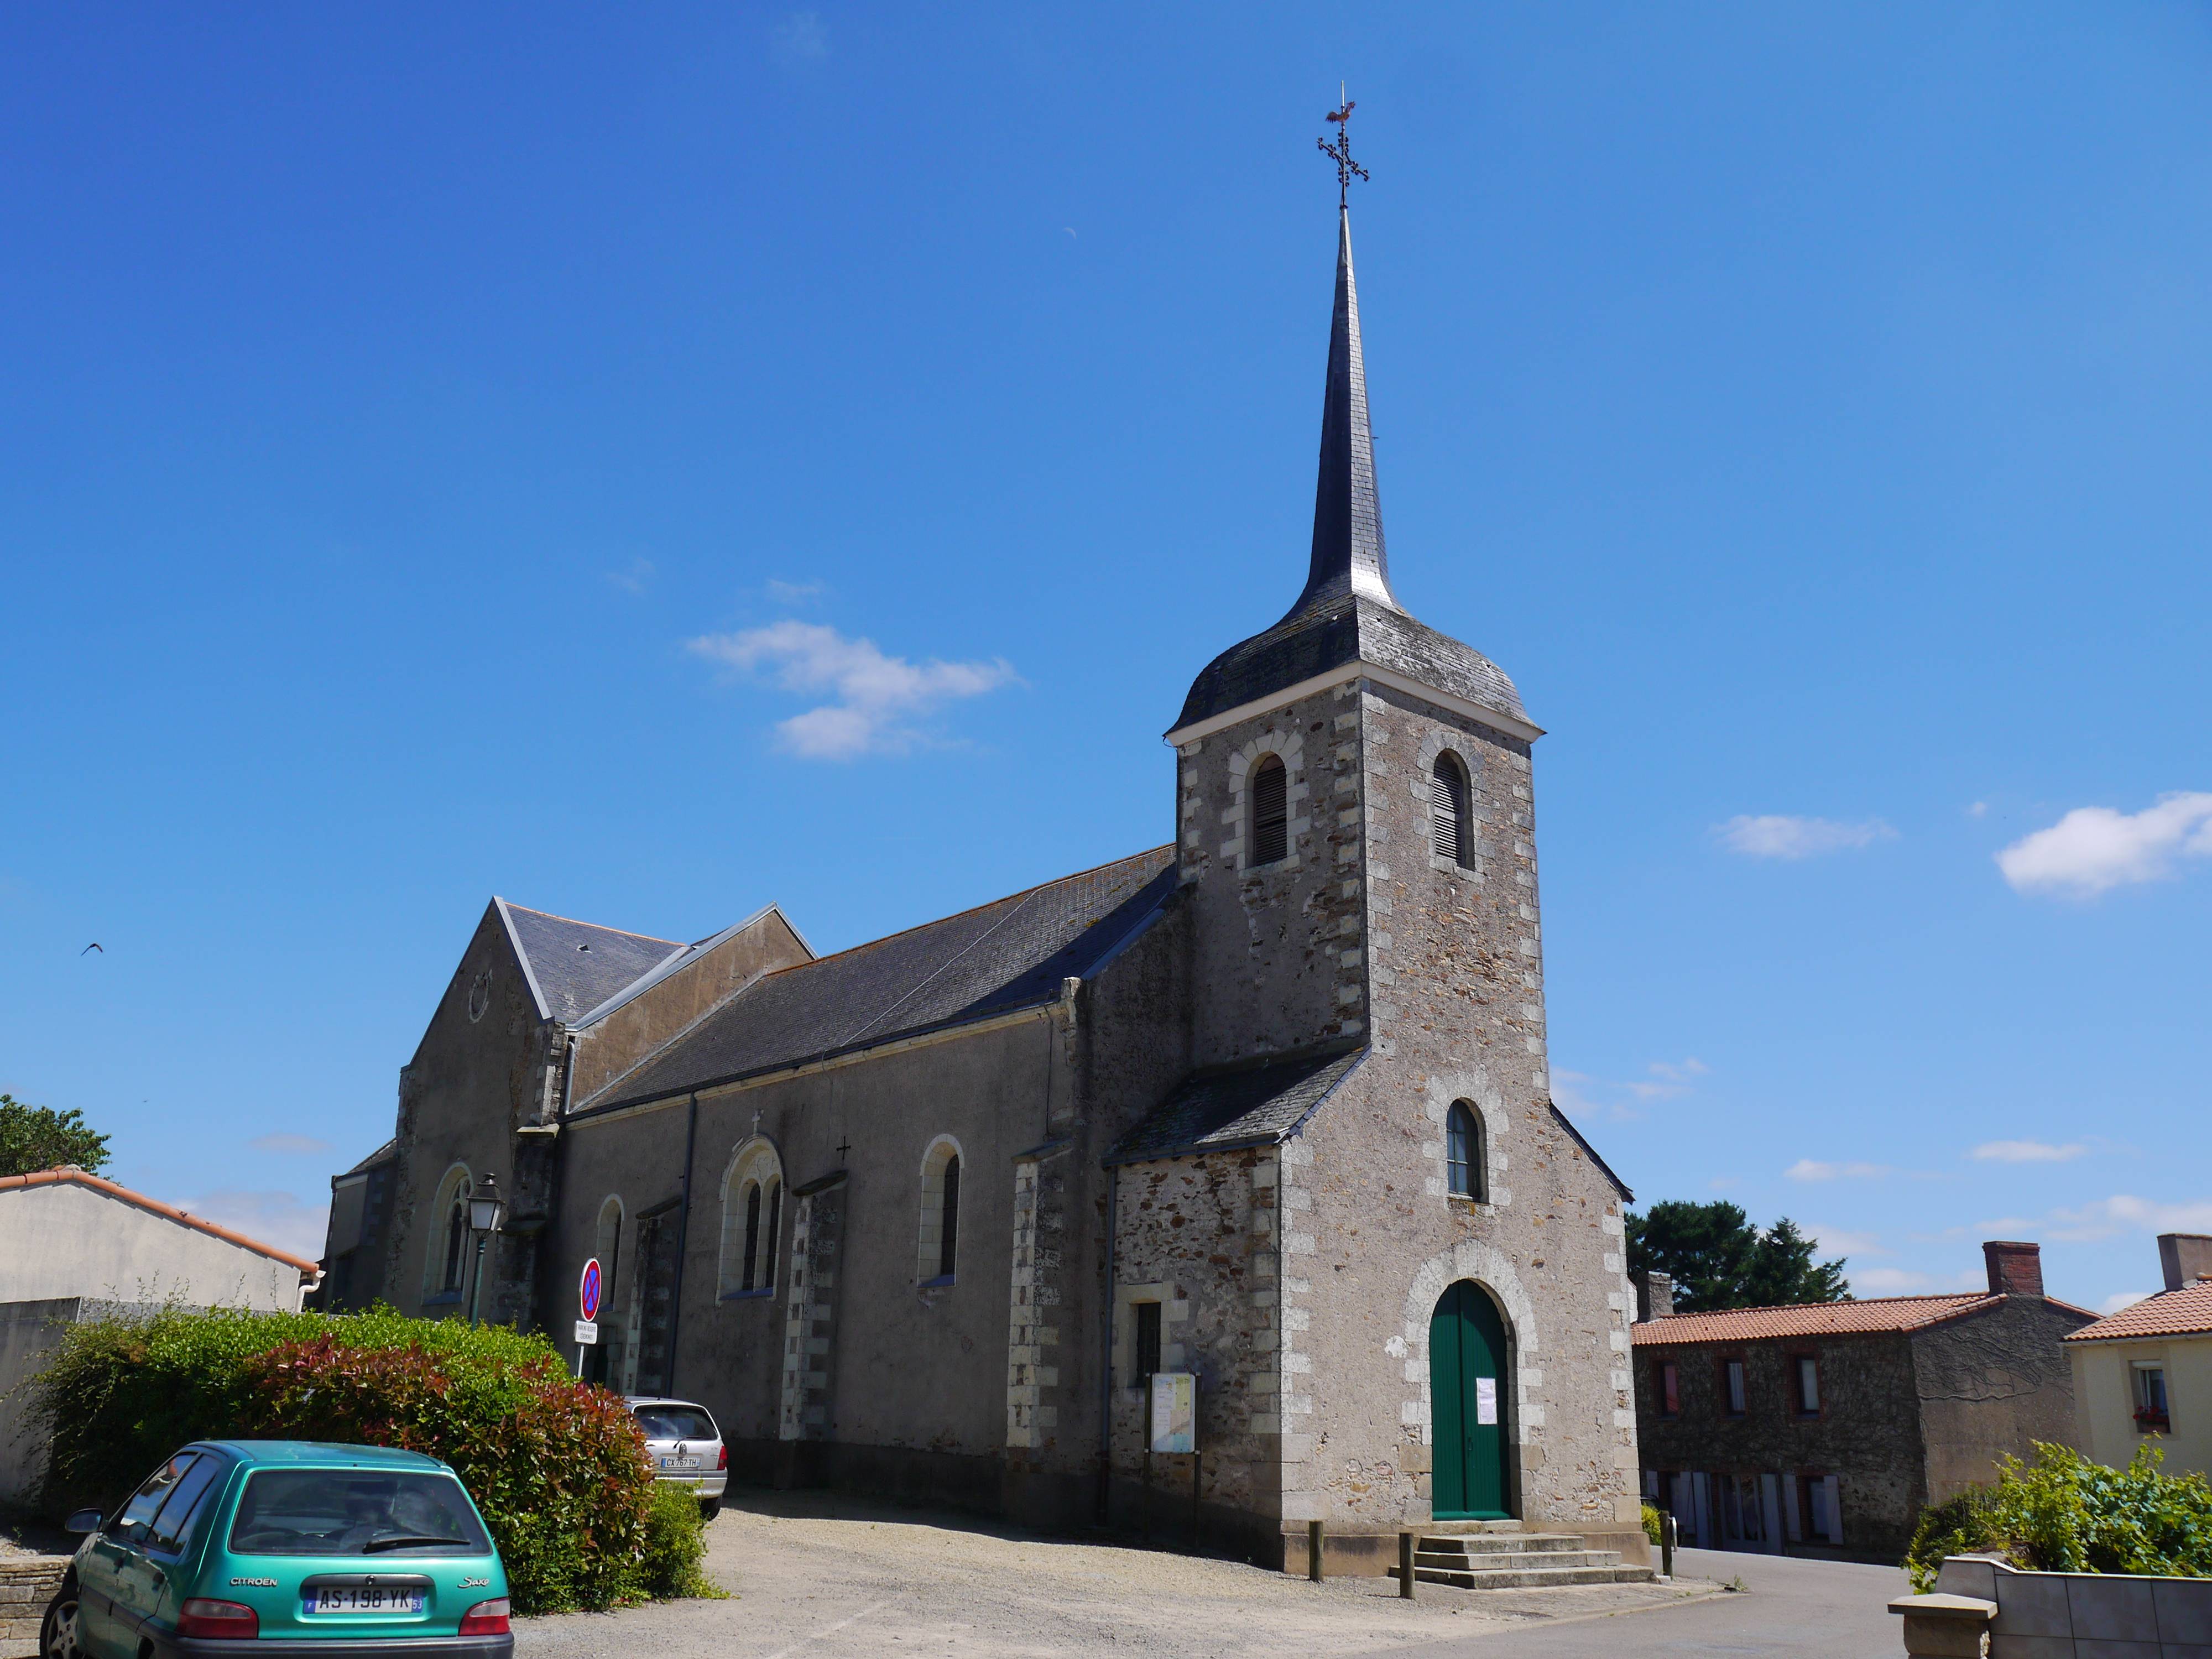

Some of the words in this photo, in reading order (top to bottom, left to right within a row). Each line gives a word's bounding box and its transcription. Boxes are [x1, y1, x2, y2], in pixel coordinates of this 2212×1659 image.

[230, 1577, 277, 1587] CITROËN
[457, 1577, 490, 1588] Saxo
[320, 1590, 410, 1608] AS-198-YK
[413, 1599, 422, 1609] 53
